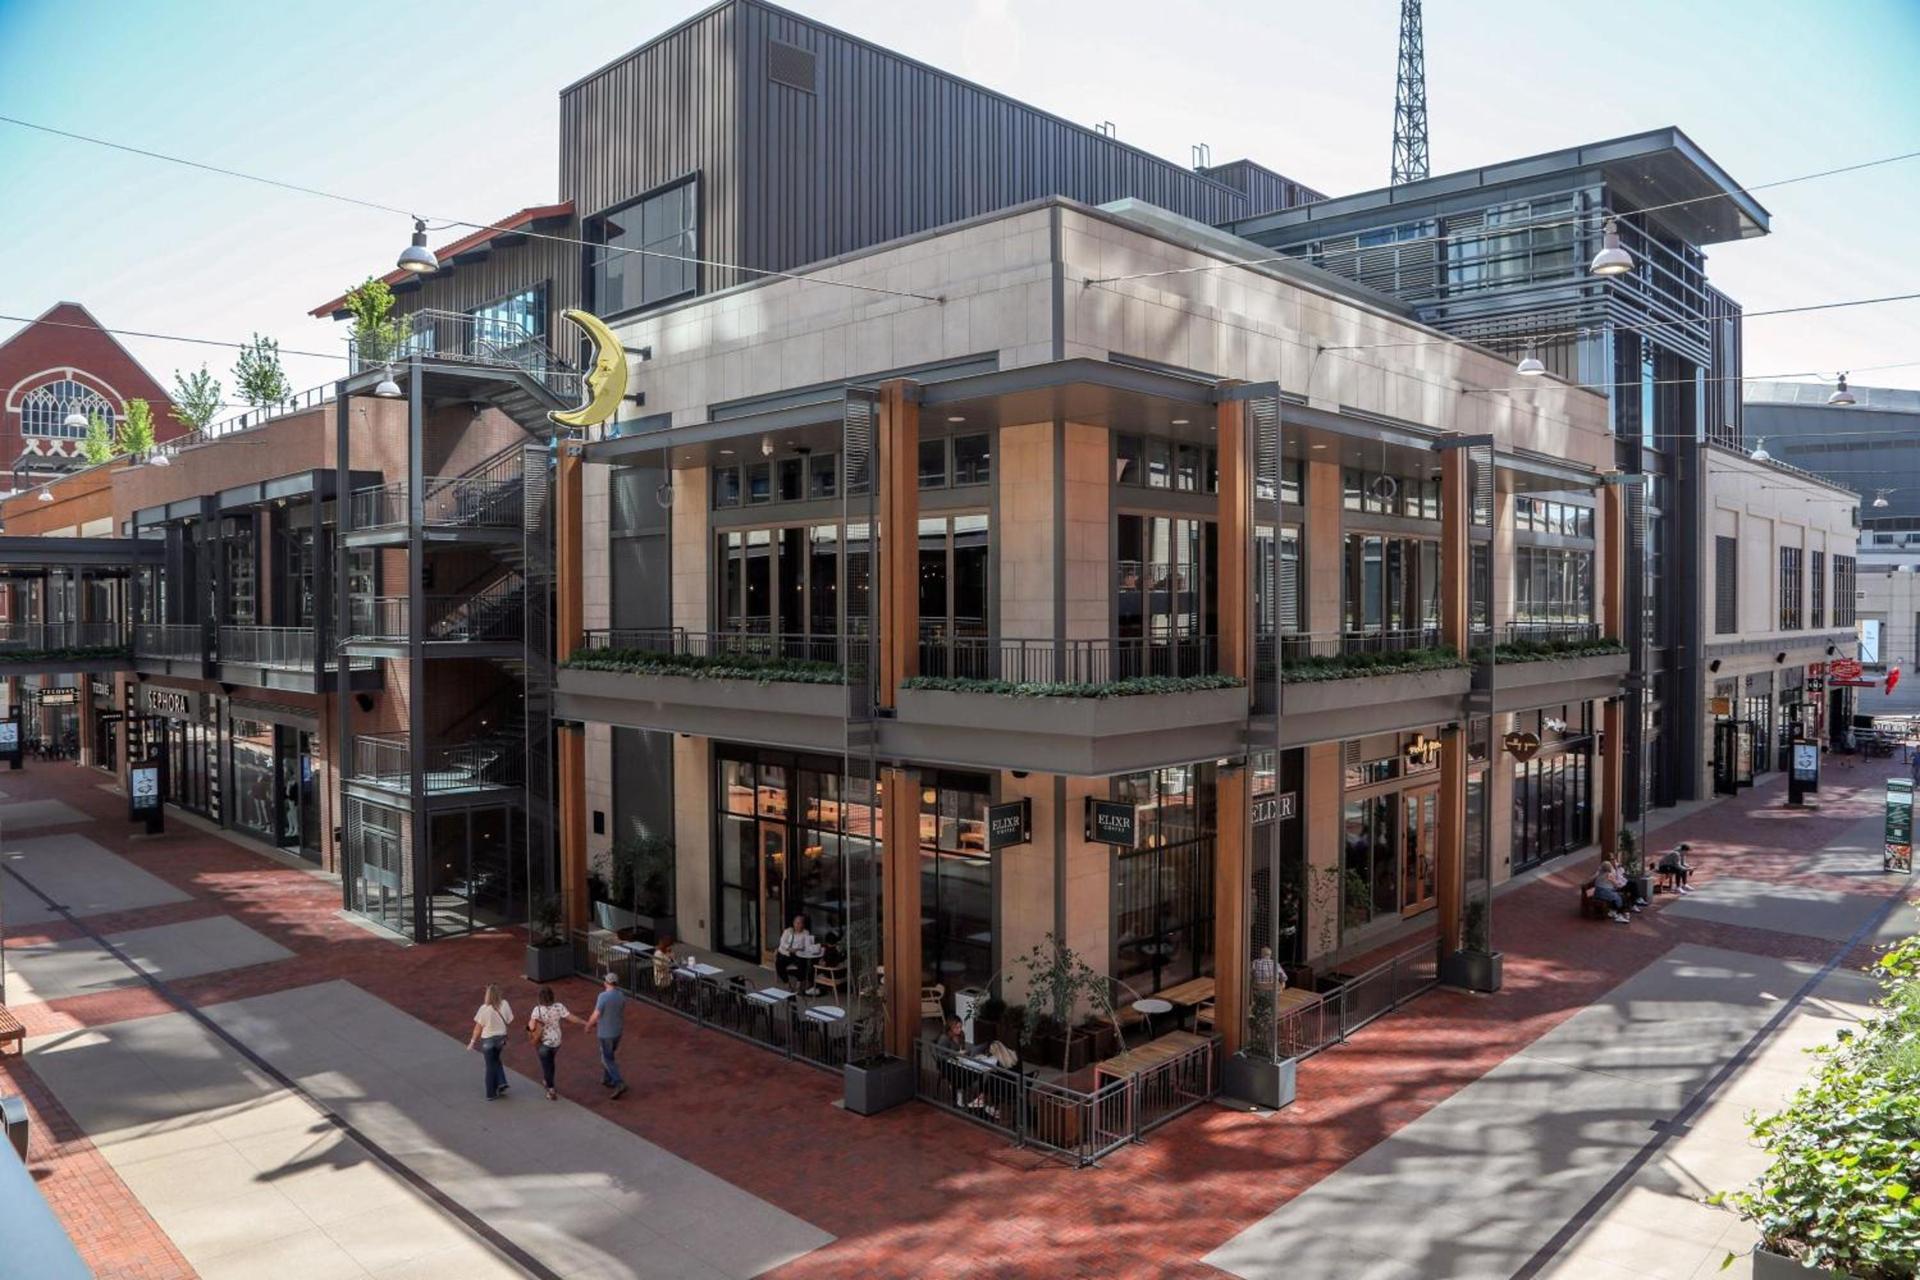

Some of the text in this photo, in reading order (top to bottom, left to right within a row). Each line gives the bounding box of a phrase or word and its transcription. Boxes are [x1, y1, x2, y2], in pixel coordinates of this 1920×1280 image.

[147, 690, 185, 713] SEPHORA
[992, 816, 1020, 831] ELIXR
[1098, 814, 1131, 829] ELIXR
